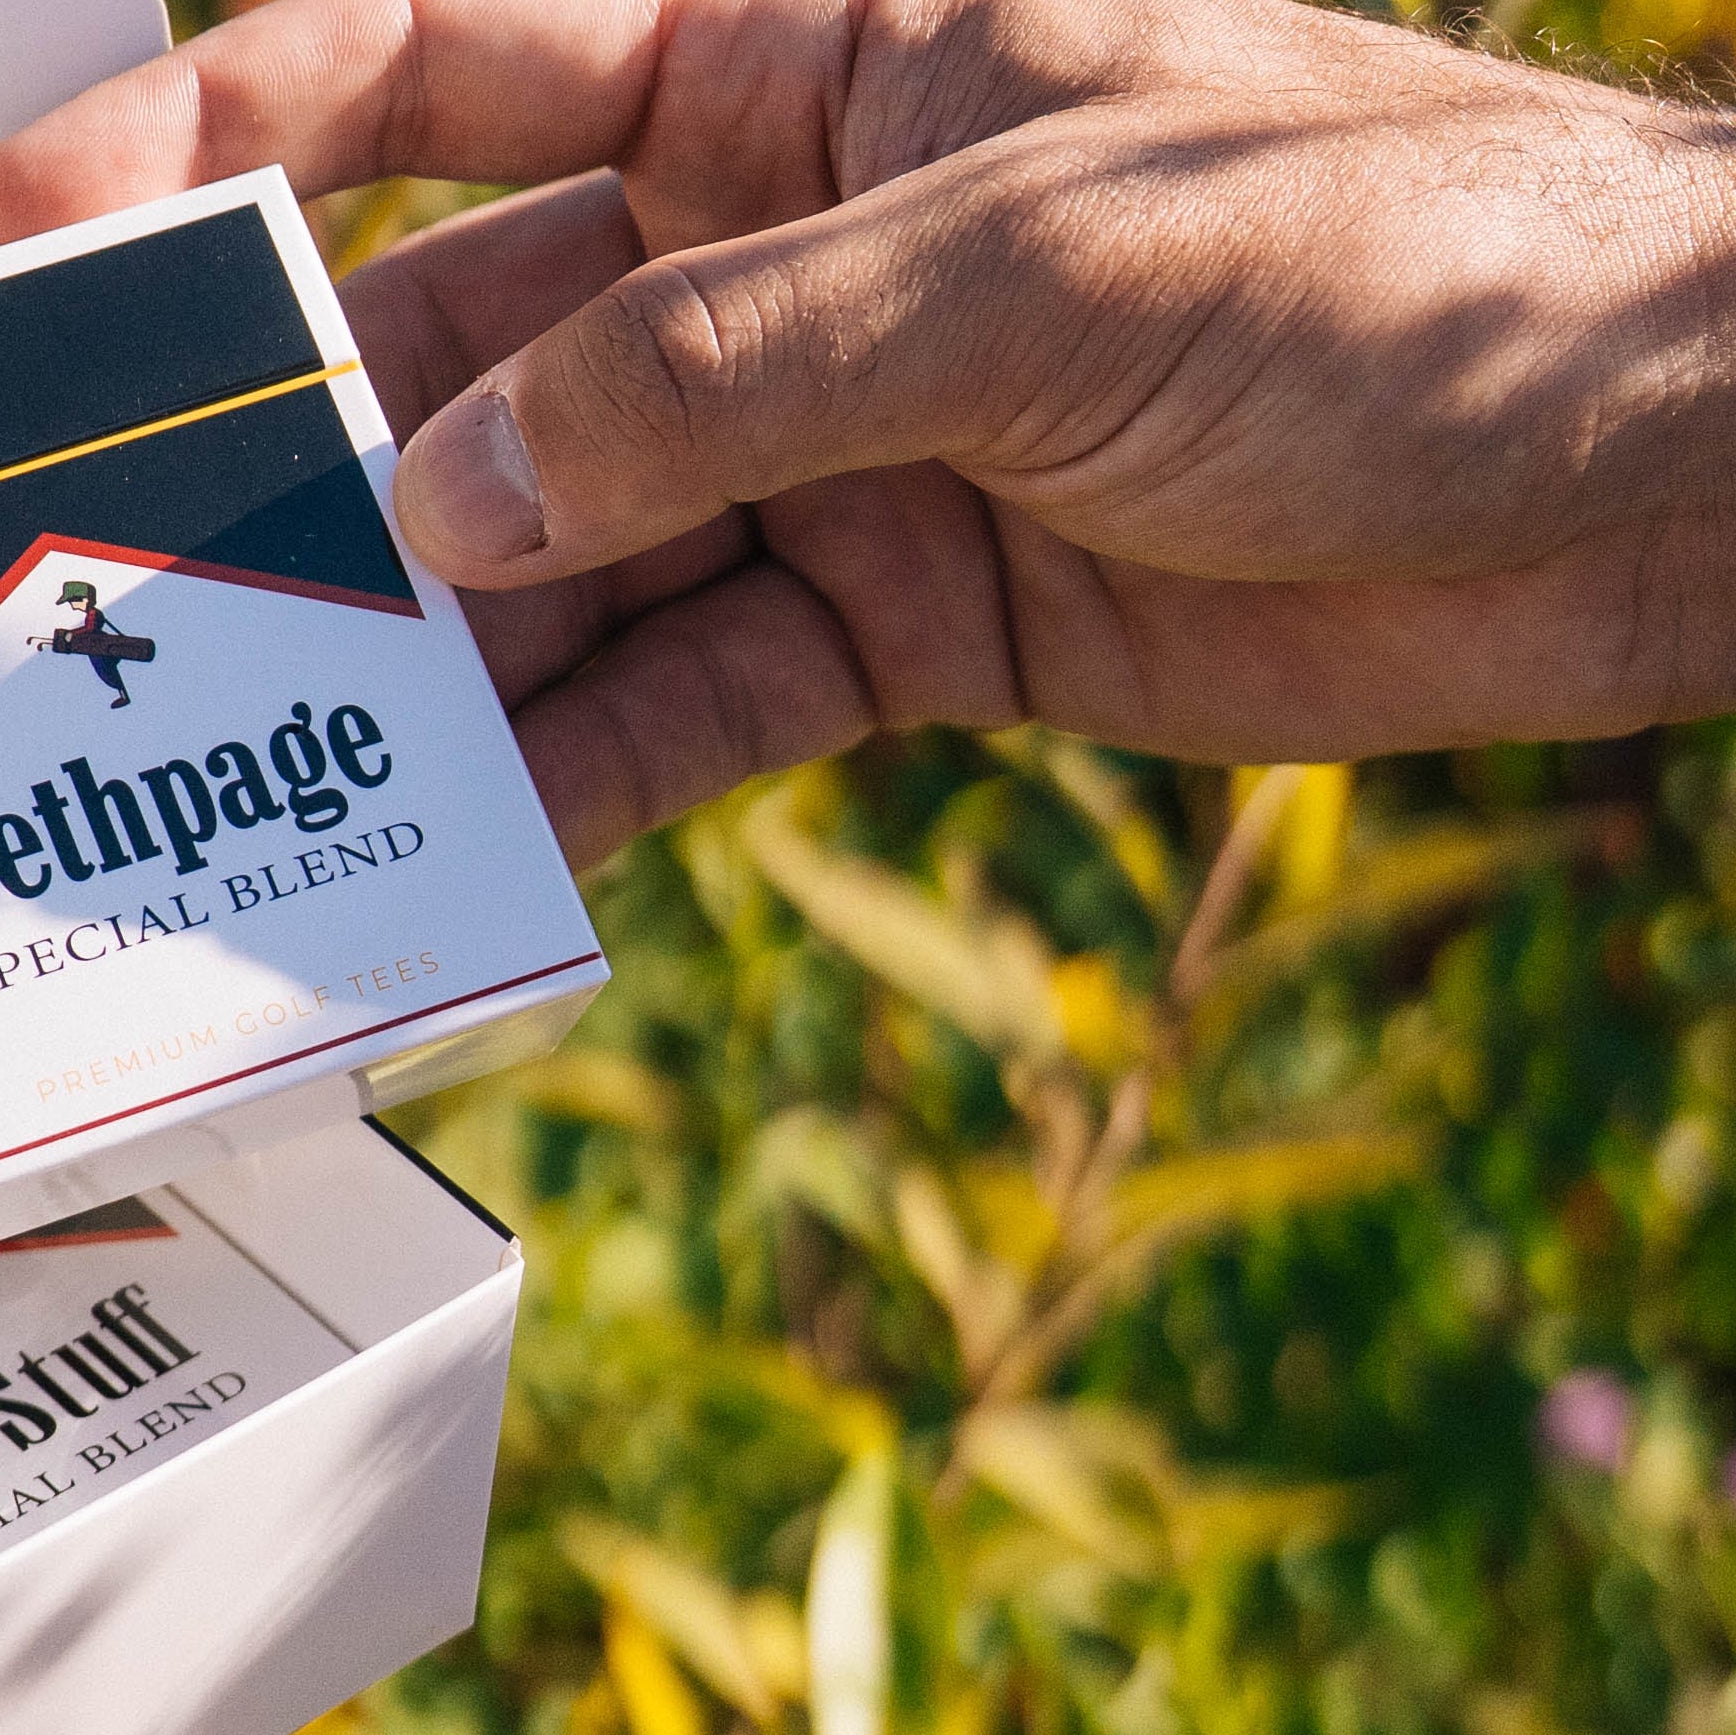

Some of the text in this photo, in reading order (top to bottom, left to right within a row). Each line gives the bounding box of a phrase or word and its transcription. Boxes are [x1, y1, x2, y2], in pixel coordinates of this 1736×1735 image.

[221, 820, 425, 916] BLEND
[37, 951, 440, 1103] PREMIUM GOLF TEES
[77, 1370, 248, 1475] BLEND
